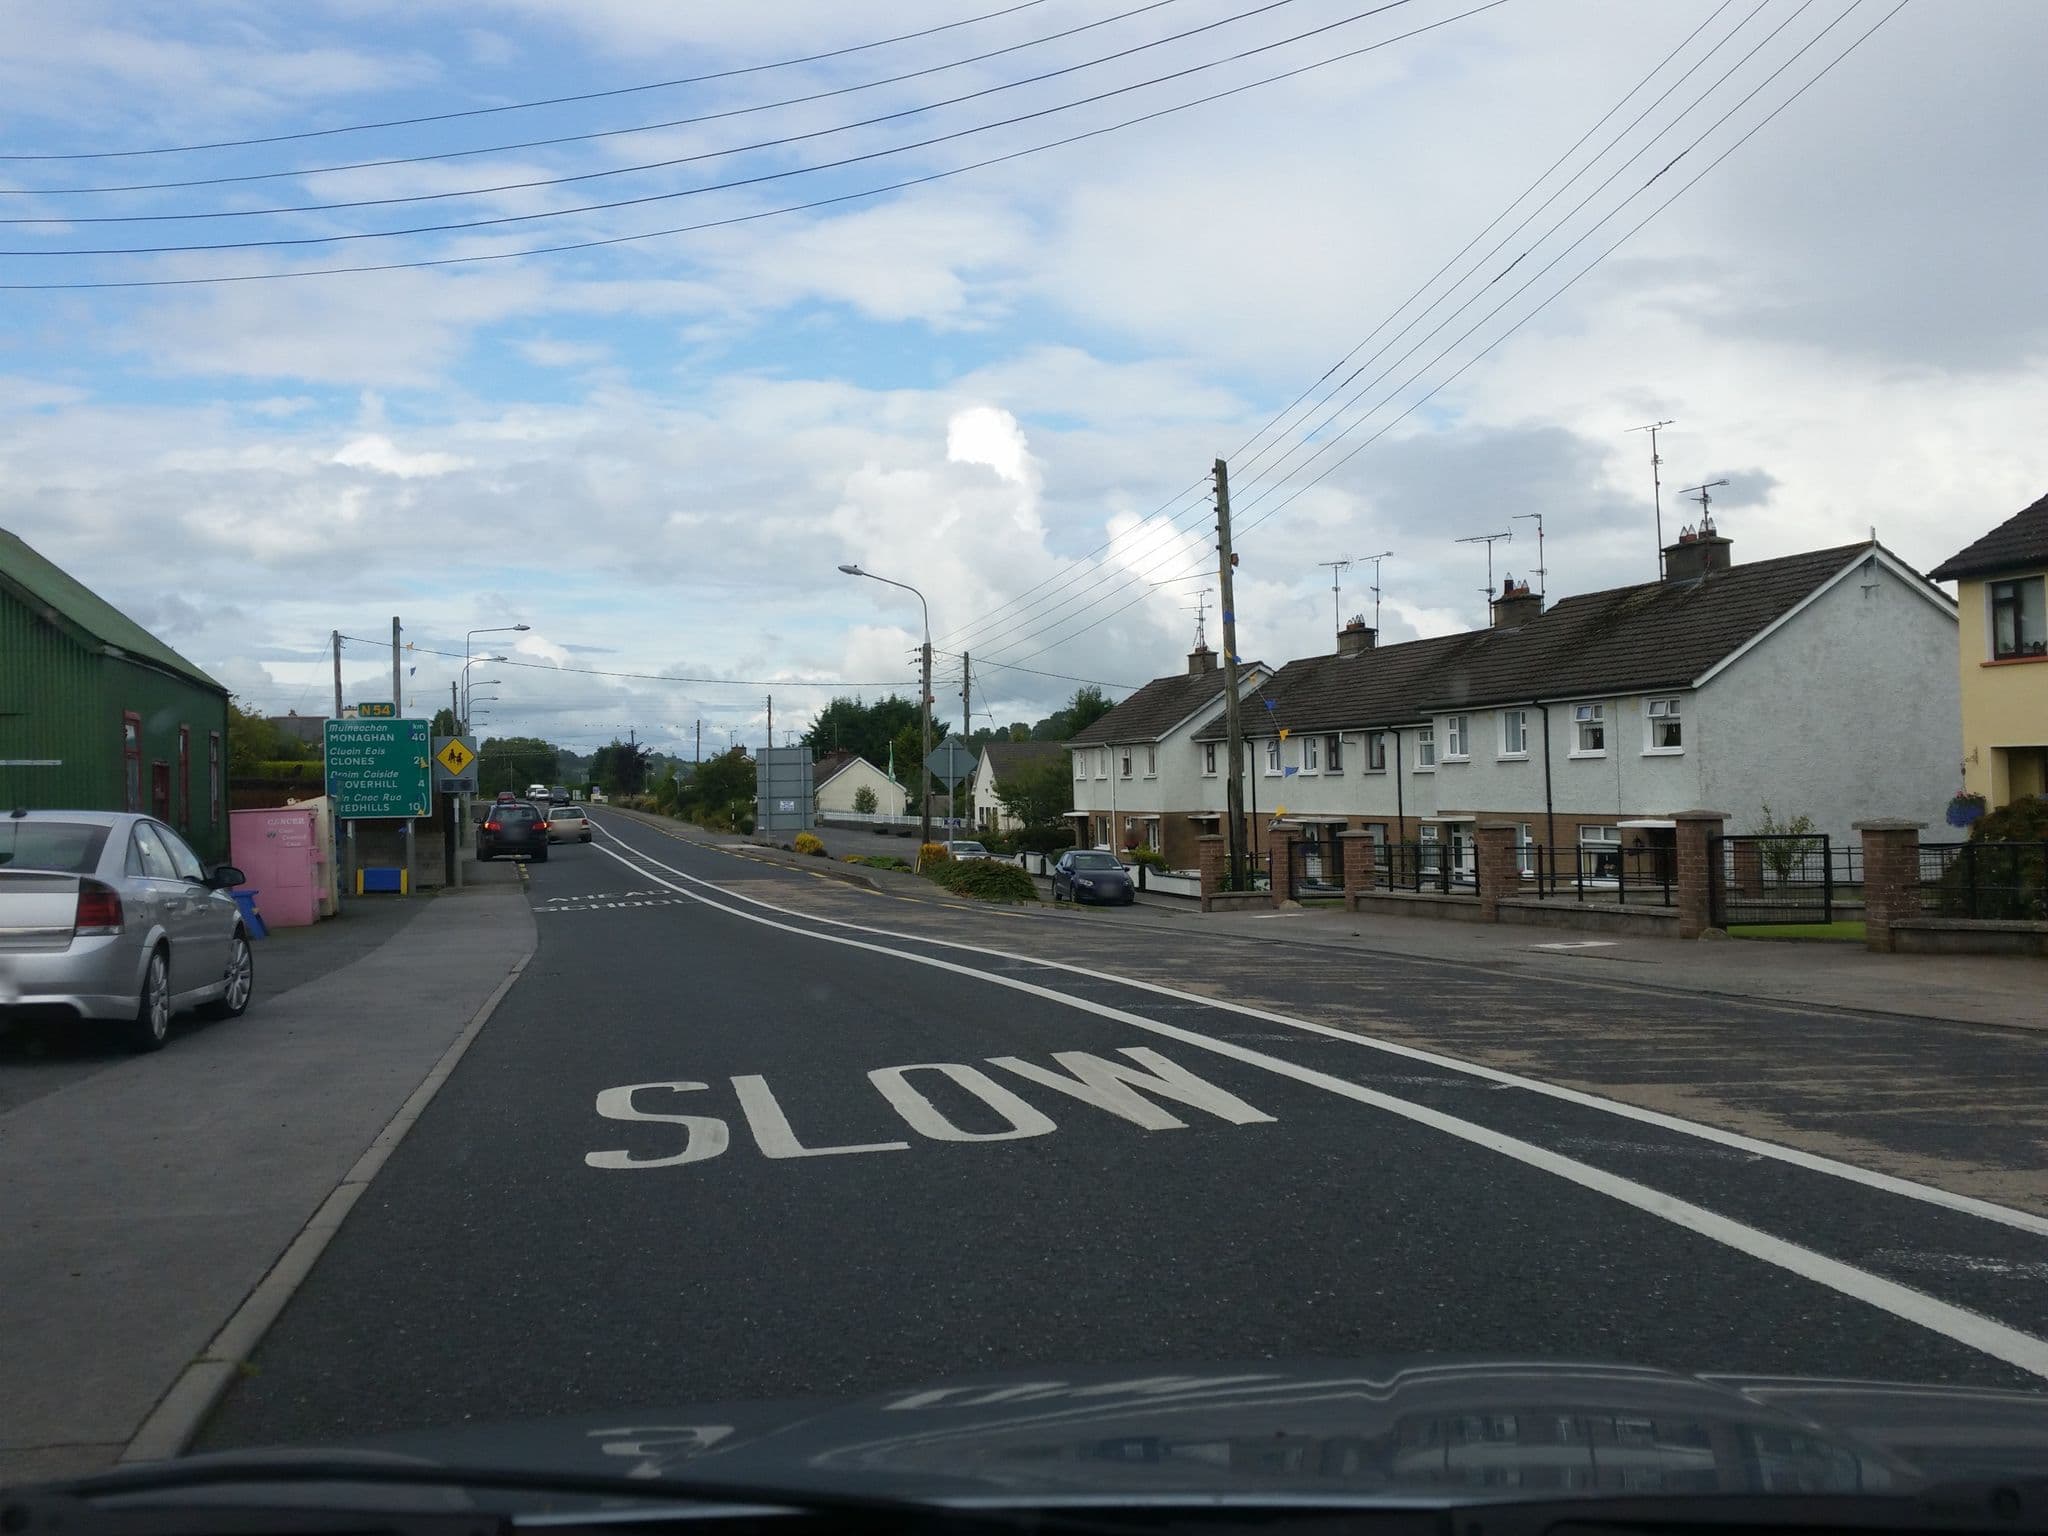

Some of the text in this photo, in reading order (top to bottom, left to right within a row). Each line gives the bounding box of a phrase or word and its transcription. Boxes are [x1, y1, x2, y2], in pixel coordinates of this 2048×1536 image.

[361, 705, 391, 715] N 54
[330, 733, 426, 742] MONAGHAN 40
[330, 747, 385, 755] Cluain Eois
[330, 757, 375, 765] CLONES
[364, 770, 399, 778] Caiside
[344, 779, 425, 788] OVERHILL 4
[354, 793, 379, 801] Cnoc
[383, 793, 402, 801] Rua
[409, 803, 420, 811] 10
[531, 899, 700, 912] SCHOOL
[585, 1046, 1279, 1169] SLOW
